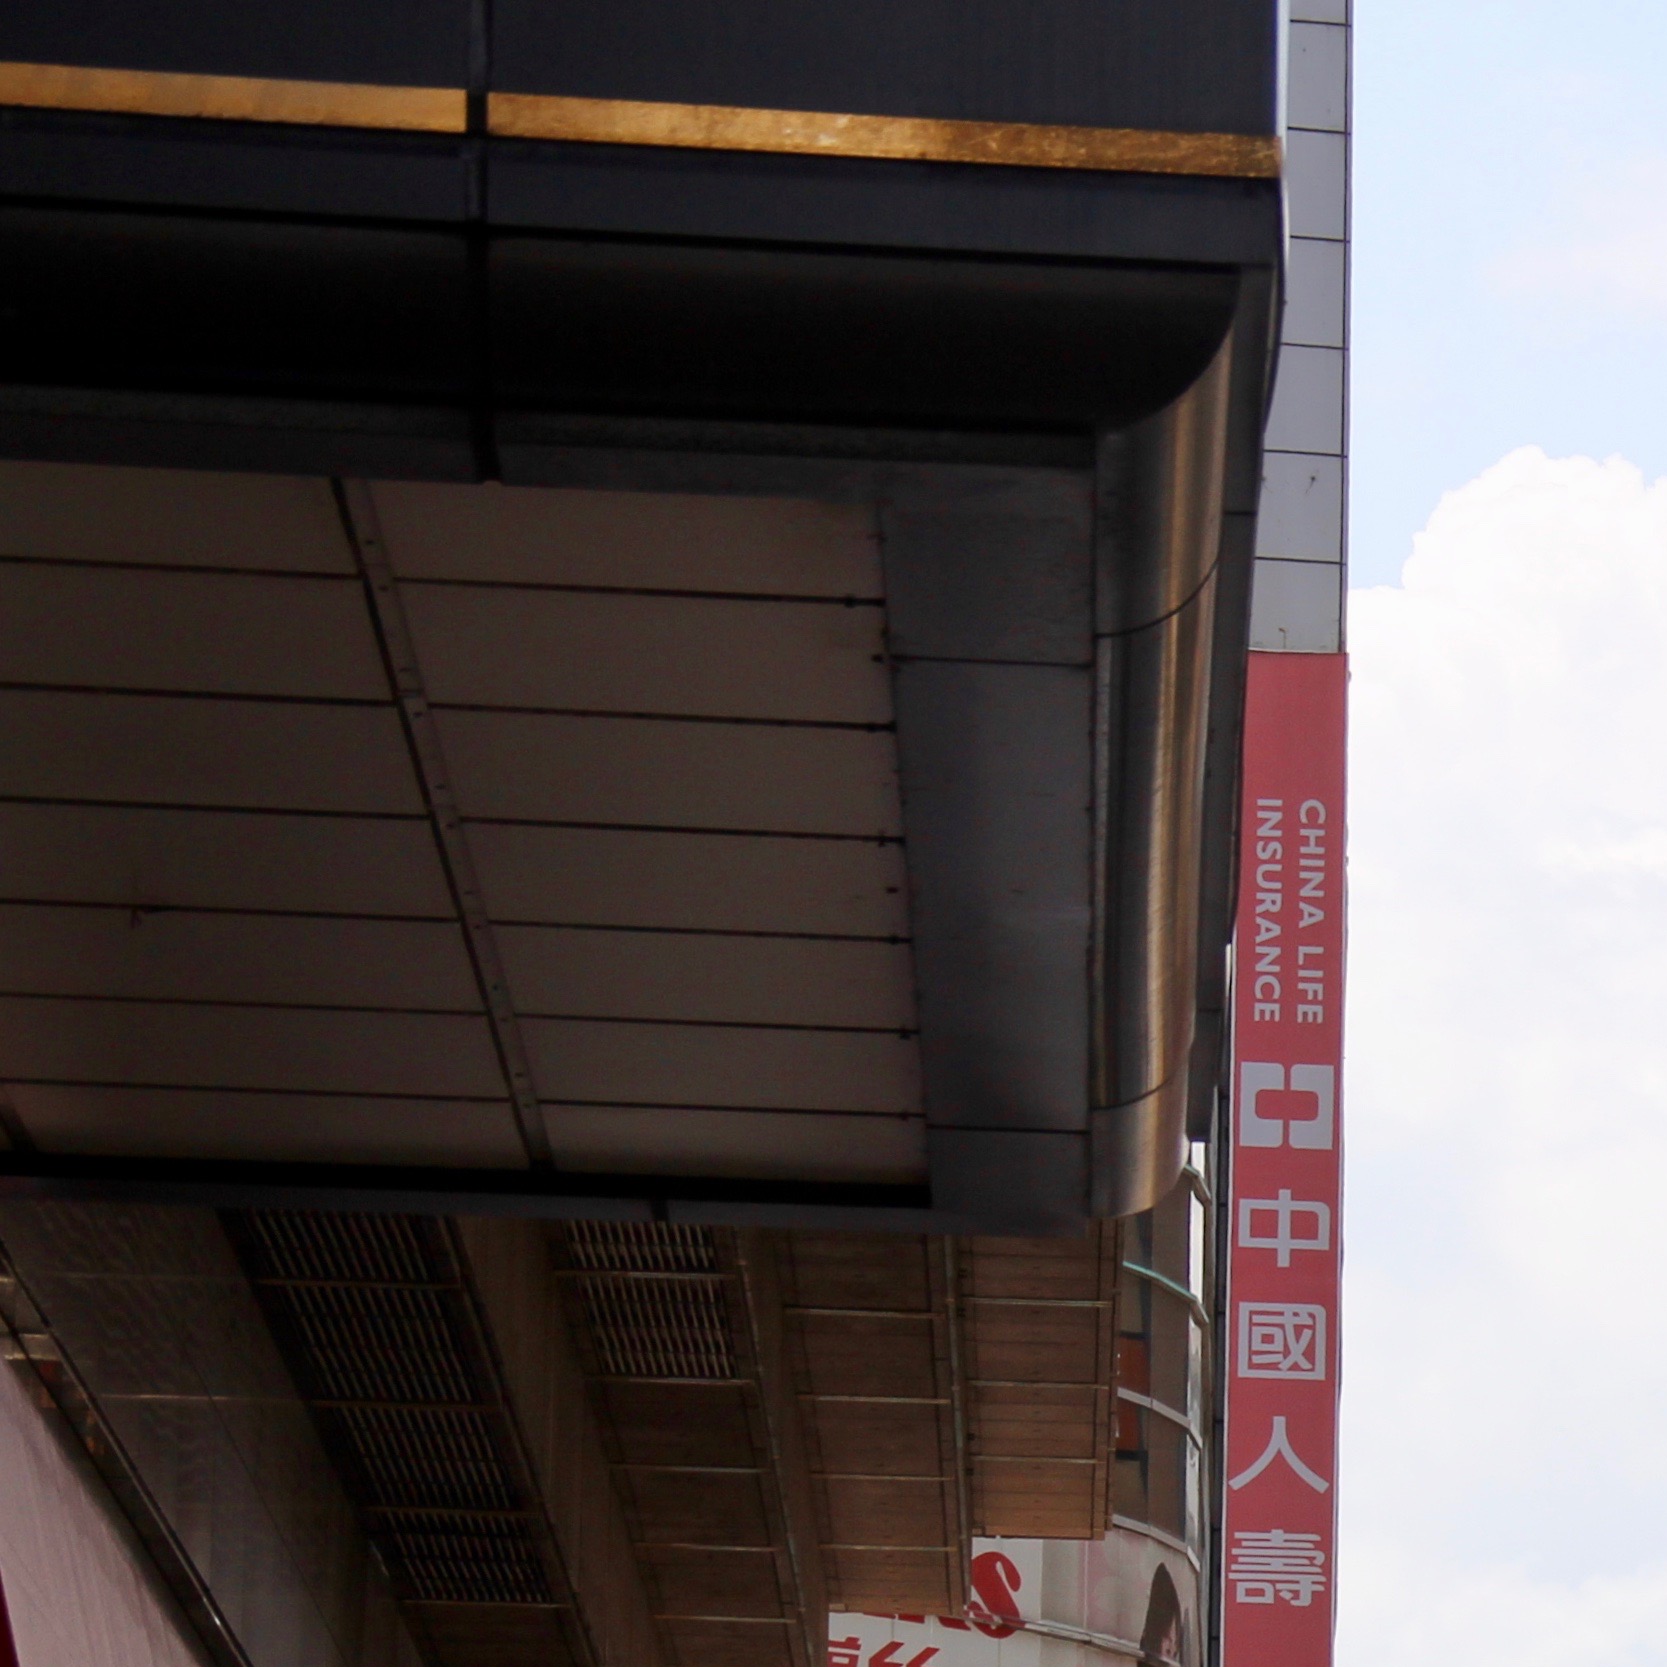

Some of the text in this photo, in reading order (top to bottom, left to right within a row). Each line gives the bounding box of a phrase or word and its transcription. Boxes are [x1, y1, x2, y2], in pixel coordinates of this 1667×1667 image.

[1253, 798, 1283, 1022] INSURANCE
[1297, 800, 1326, 1025] CHINA LIFE
[1228, 1189, 1330, 1606] 中國人壽
